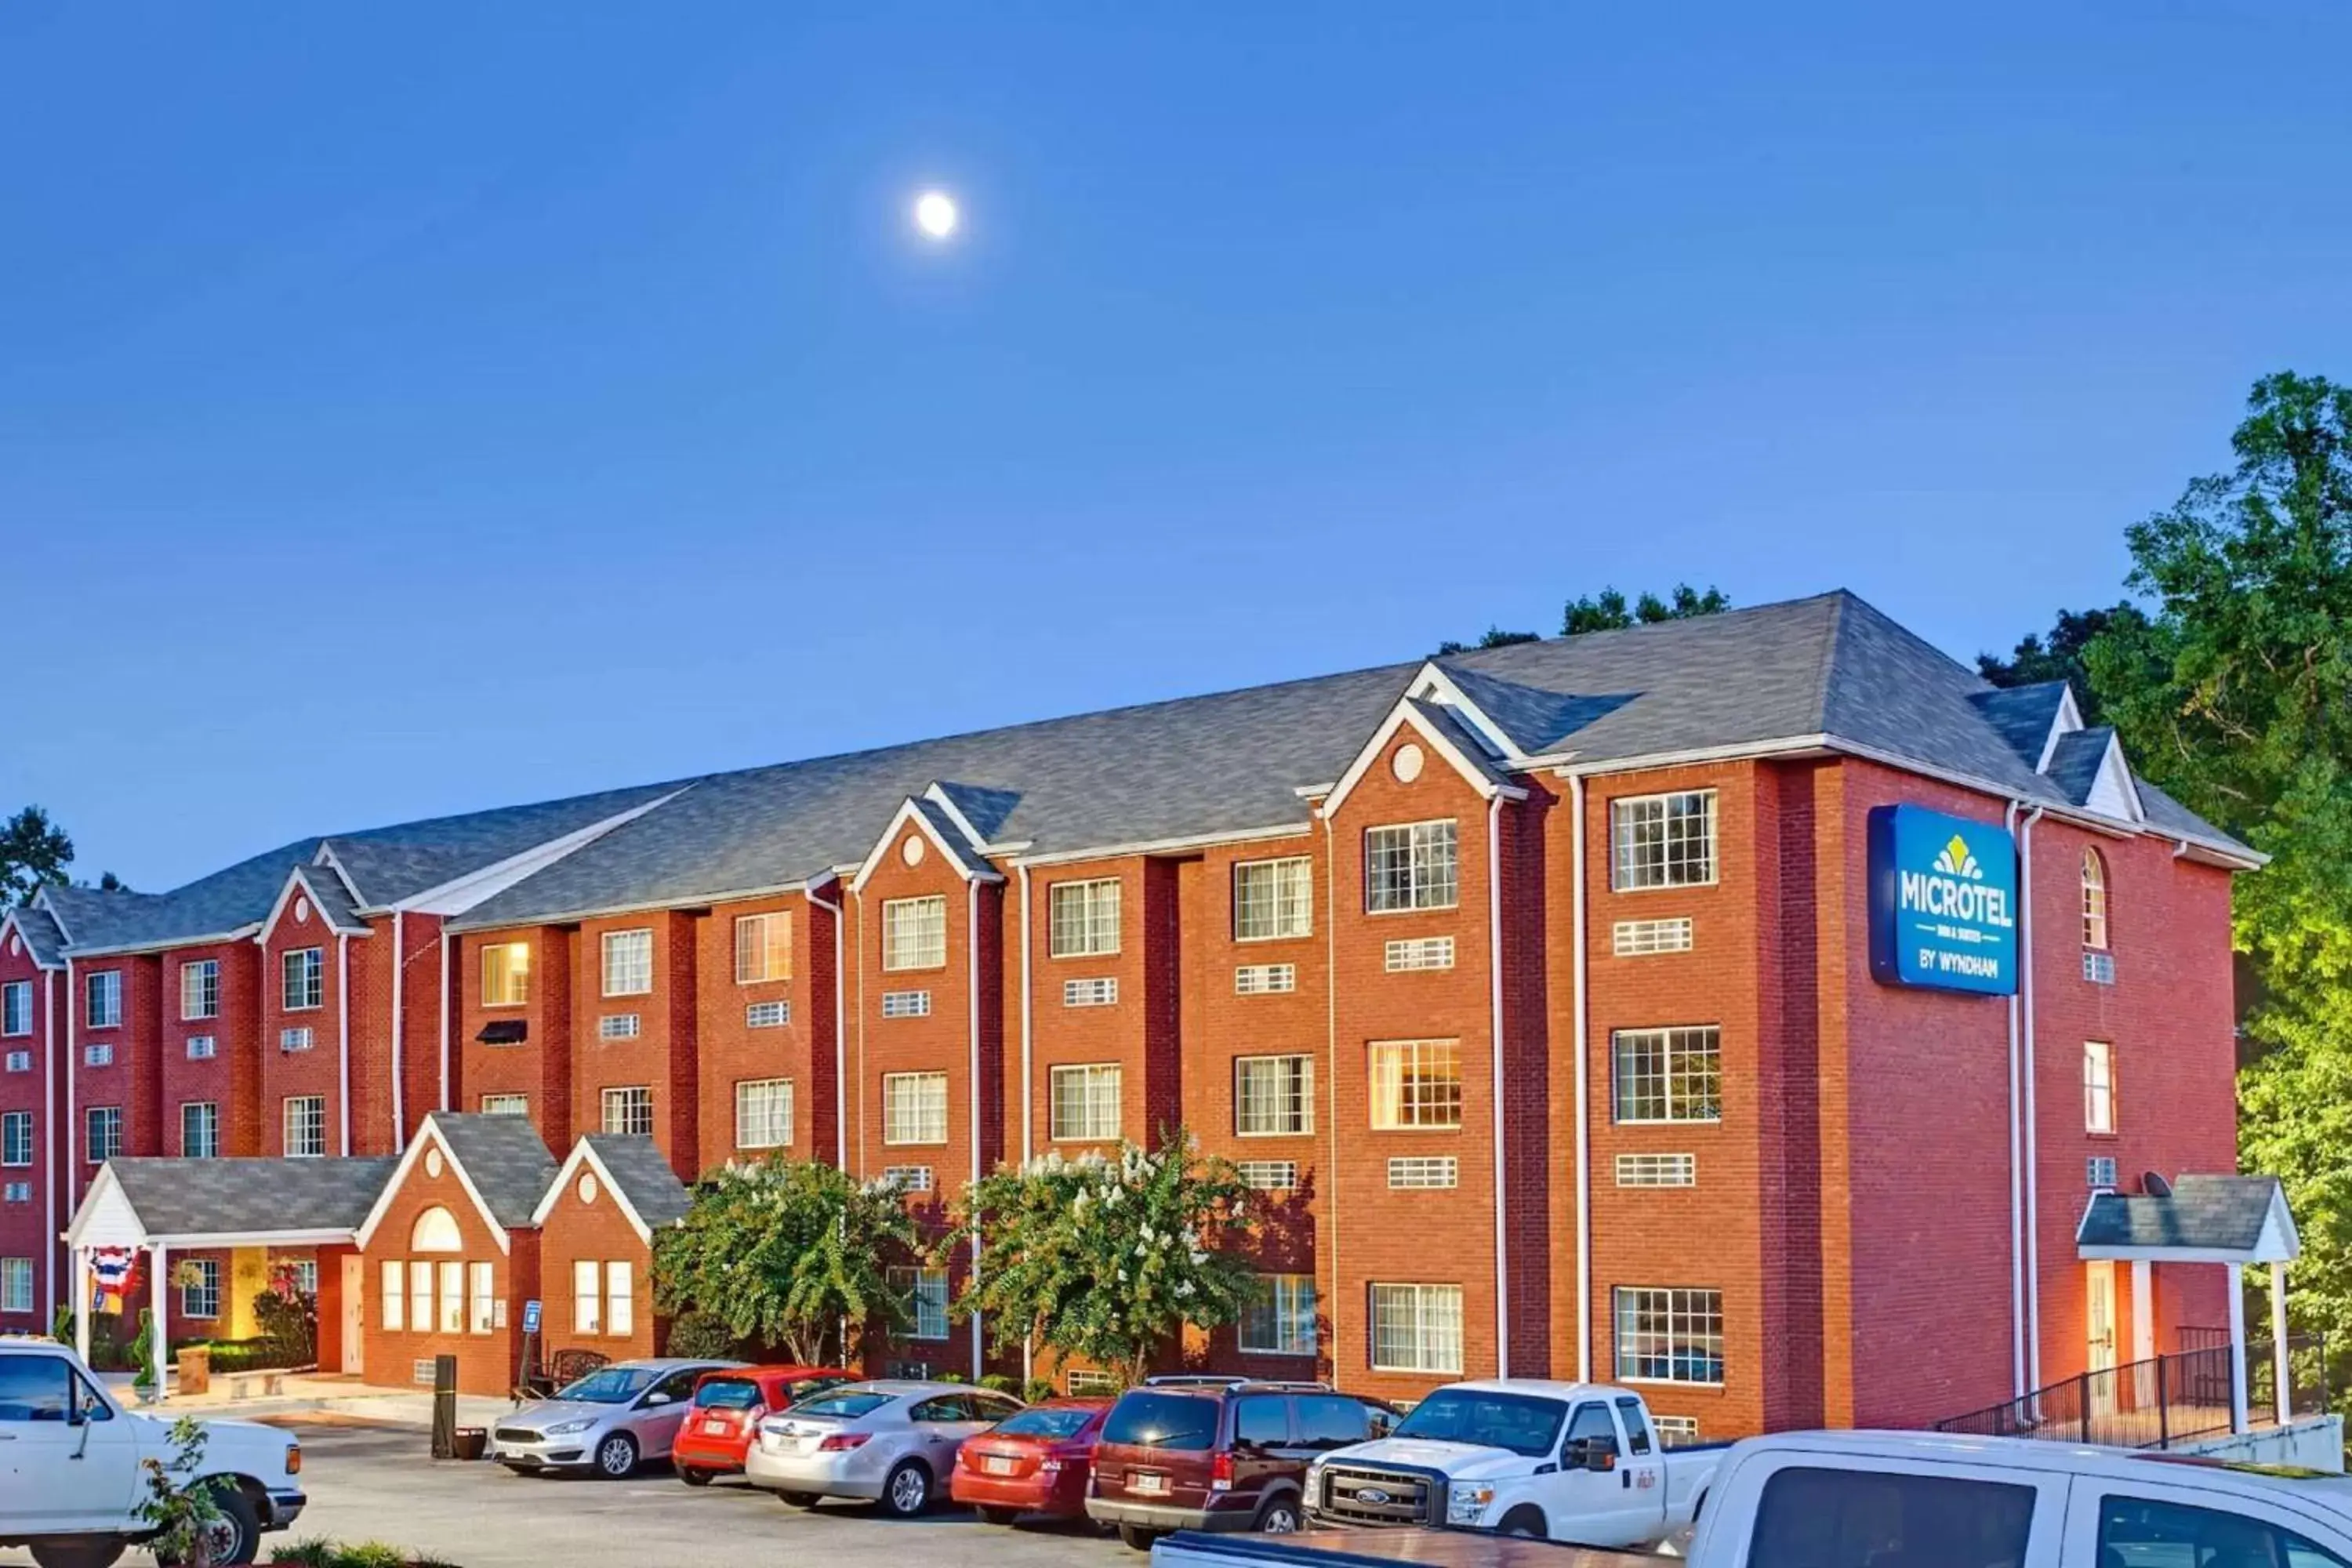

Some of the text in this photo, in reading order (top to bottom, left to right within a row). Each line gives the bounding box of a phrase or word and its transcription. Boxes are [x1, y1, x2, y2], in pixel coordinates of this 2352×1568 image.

[1901, 870, 2013, 927] MICROTEL
[1919, 949, 1998, 978] BY WYNDHAM
